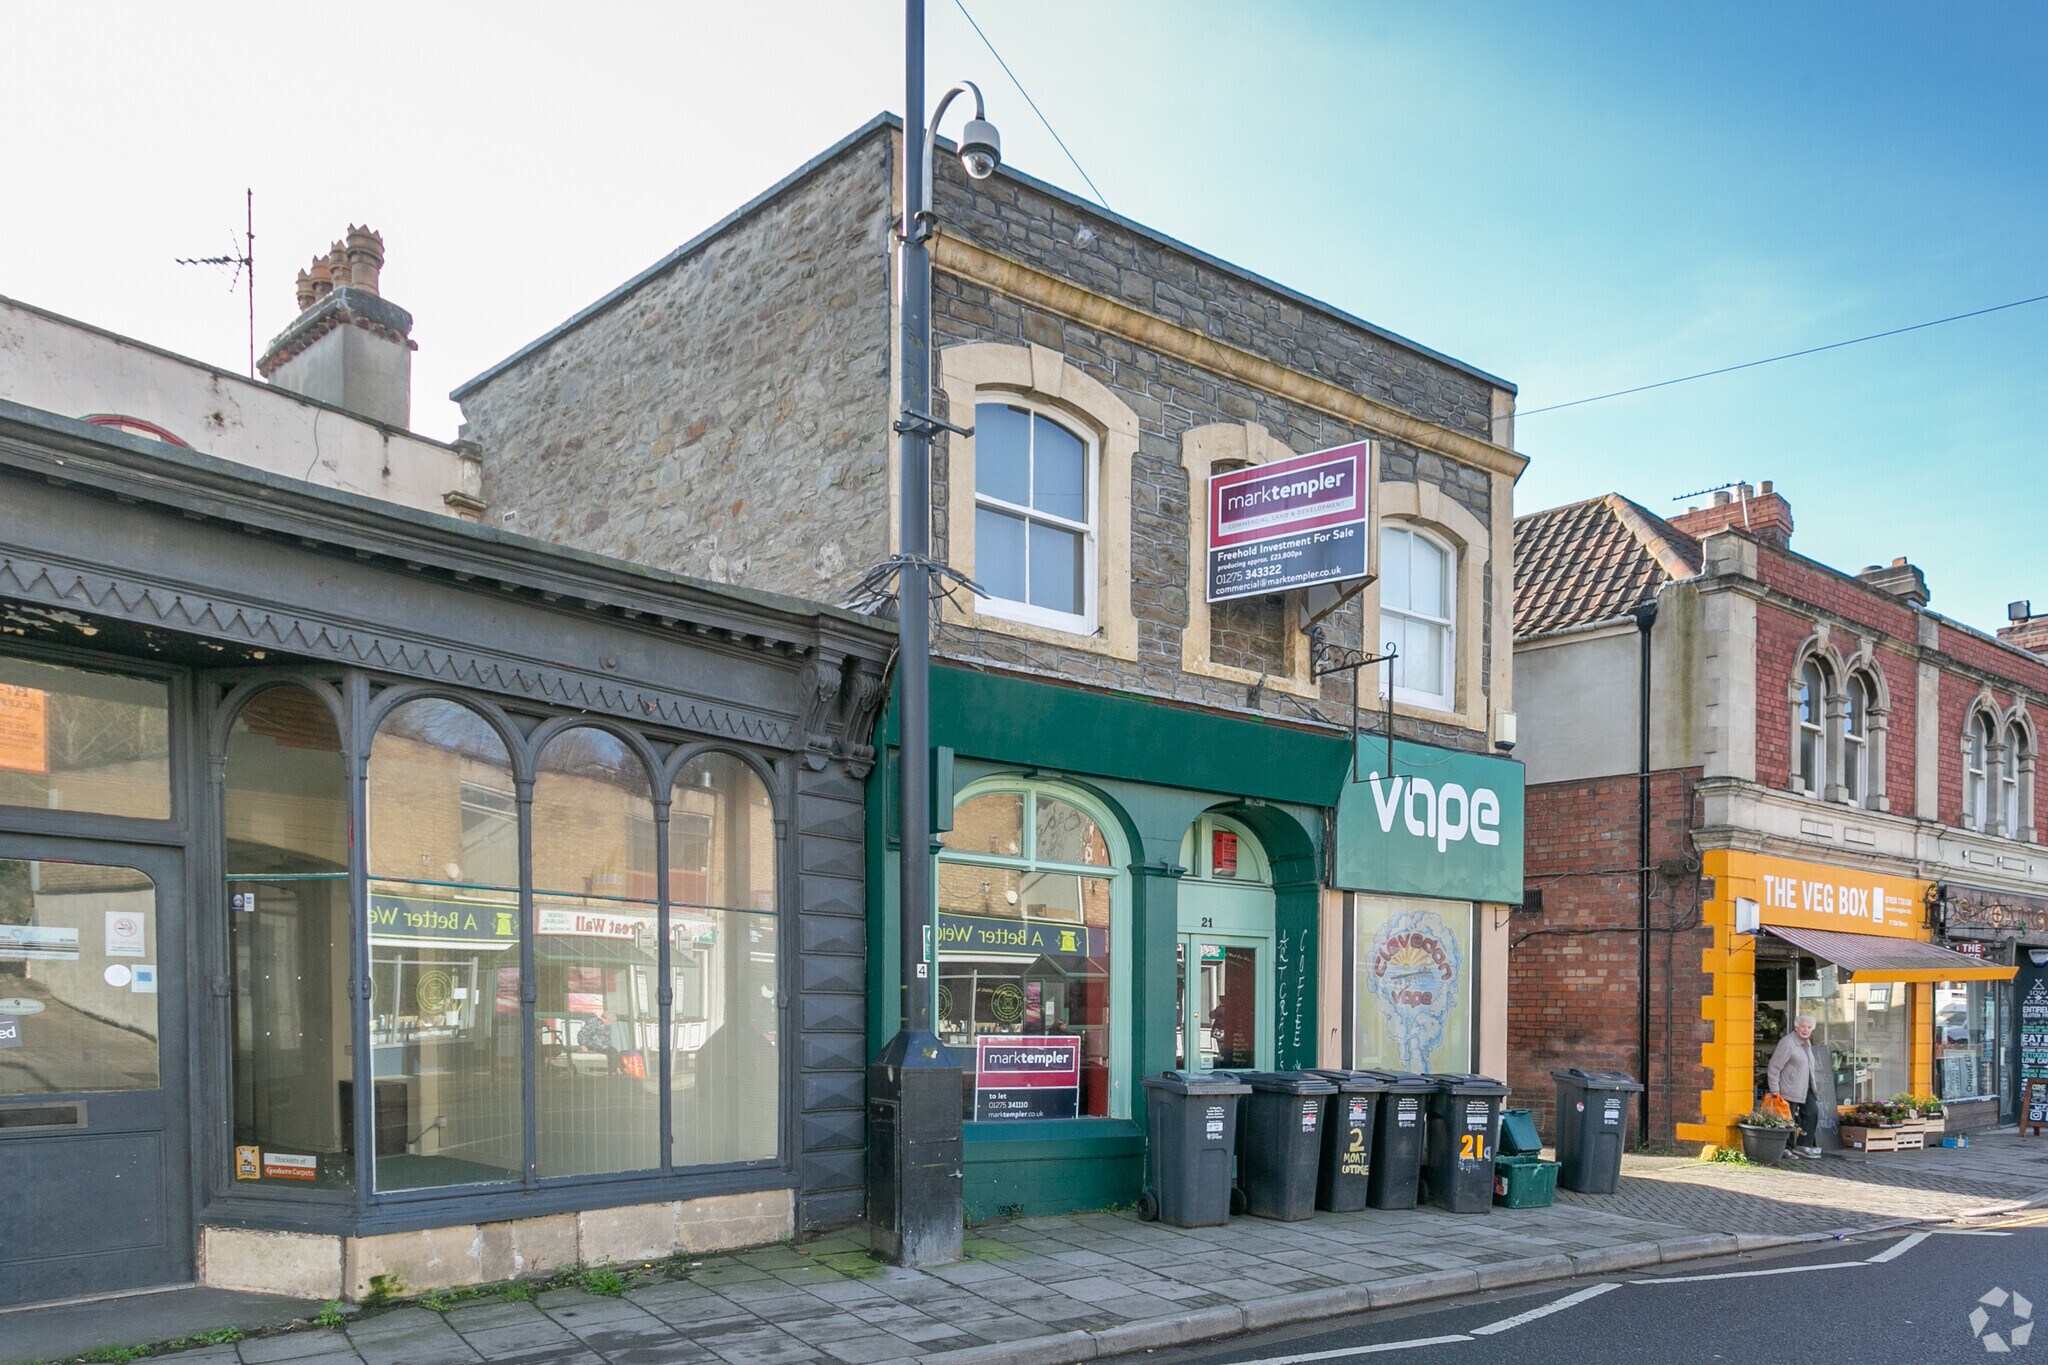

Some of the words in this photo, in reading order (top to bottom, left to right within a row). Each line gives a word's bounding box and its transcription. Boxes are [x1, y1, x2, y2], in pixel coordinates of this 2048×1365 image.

[1228, 471, 1346, 511] marktempler
[1271, 512, 1288, 521] LAND
[1297, 500, 1345, 516] DEVELOPMENT
[1217, 545, 1257, 562] Freehold
[1260, 537, 1311, 554] Investment
[1314, 532, 1331, 544] For
[1333, 528, 1354, 540] Sale
[1217, 560, 1246, 572] producing
[1247, 556, 1268, 566] approx.
[1215, 565, 1342, 595] commercial@marktempler.co.uk
[1216, 570, 1243, 585] 01275
[1245, 564, 1282, 580] 343322
[1763, 874, 1798, 909] THE
[1801, 880, 1834, 914] VEG
[1838, 886, 1869, 918] BOX
[1201, 917, 1213, 928] 21
[1962, 943, 1982, 953] THE
[918, 965, 926, 976] 4
[2022, 1034, 2043, 1043] EAT
[989, 1050, 1070, 1068] marktempler
[1964, 1054, 1974, 1093] CHIMNEYS
[997, 1092, 1007, 1100] let
[988, 1101, 1007, 1109] 01275
[1007, 1101, 1029, 1109] 341110
[988, 1110, 1044, 1119] marktempler.co.uk
[1349, 1127, 1365, 1153] 2
[1460, 1134, 1484, 1159] 21
[274, 1156, 299, 1164] Stockists
[1343, 1152, 1367, 1164] MOAT
[266, 1166, 292, 1176] Goodacre
[292, 1168, 314, 1177] Carpets
